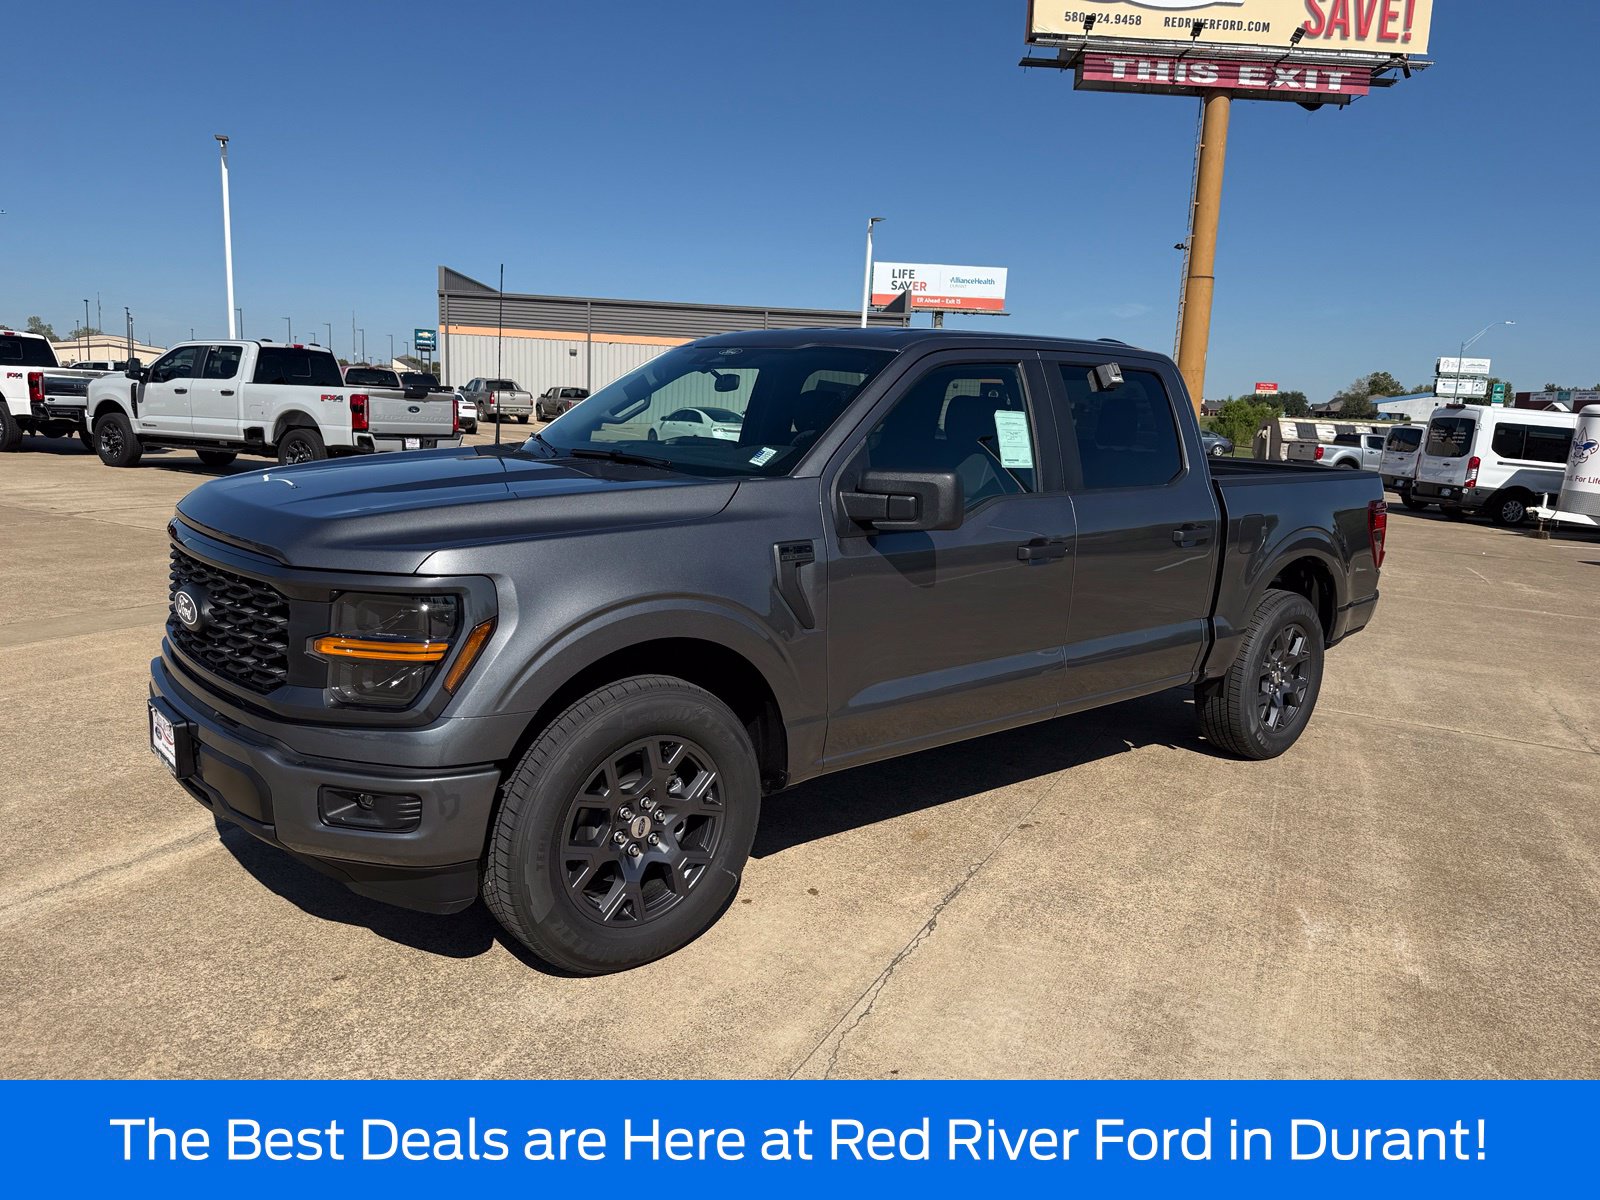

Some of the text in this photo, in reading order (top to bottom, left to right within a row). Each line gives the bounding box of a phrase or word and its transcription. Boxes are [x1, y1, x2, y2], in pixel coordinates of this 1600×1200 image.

[1064, 11, 1142, 26] 580924.9458
[1163, 16, 1271, 33] REDRERFORD.COM
[1302, 0, 1416, 42] SAVE!
[1105, 57, 1351, 91] THIS EXIT
[892, 268, 915, 279] LIFE
[890, 280, 927, 291] SAVER
[949, 276, 995, 285] AllianceHealth
[320, 394, 344, 402] FX4
[1574, 475, 1586, 483] For
[178, 594, 192, 621] Ford
